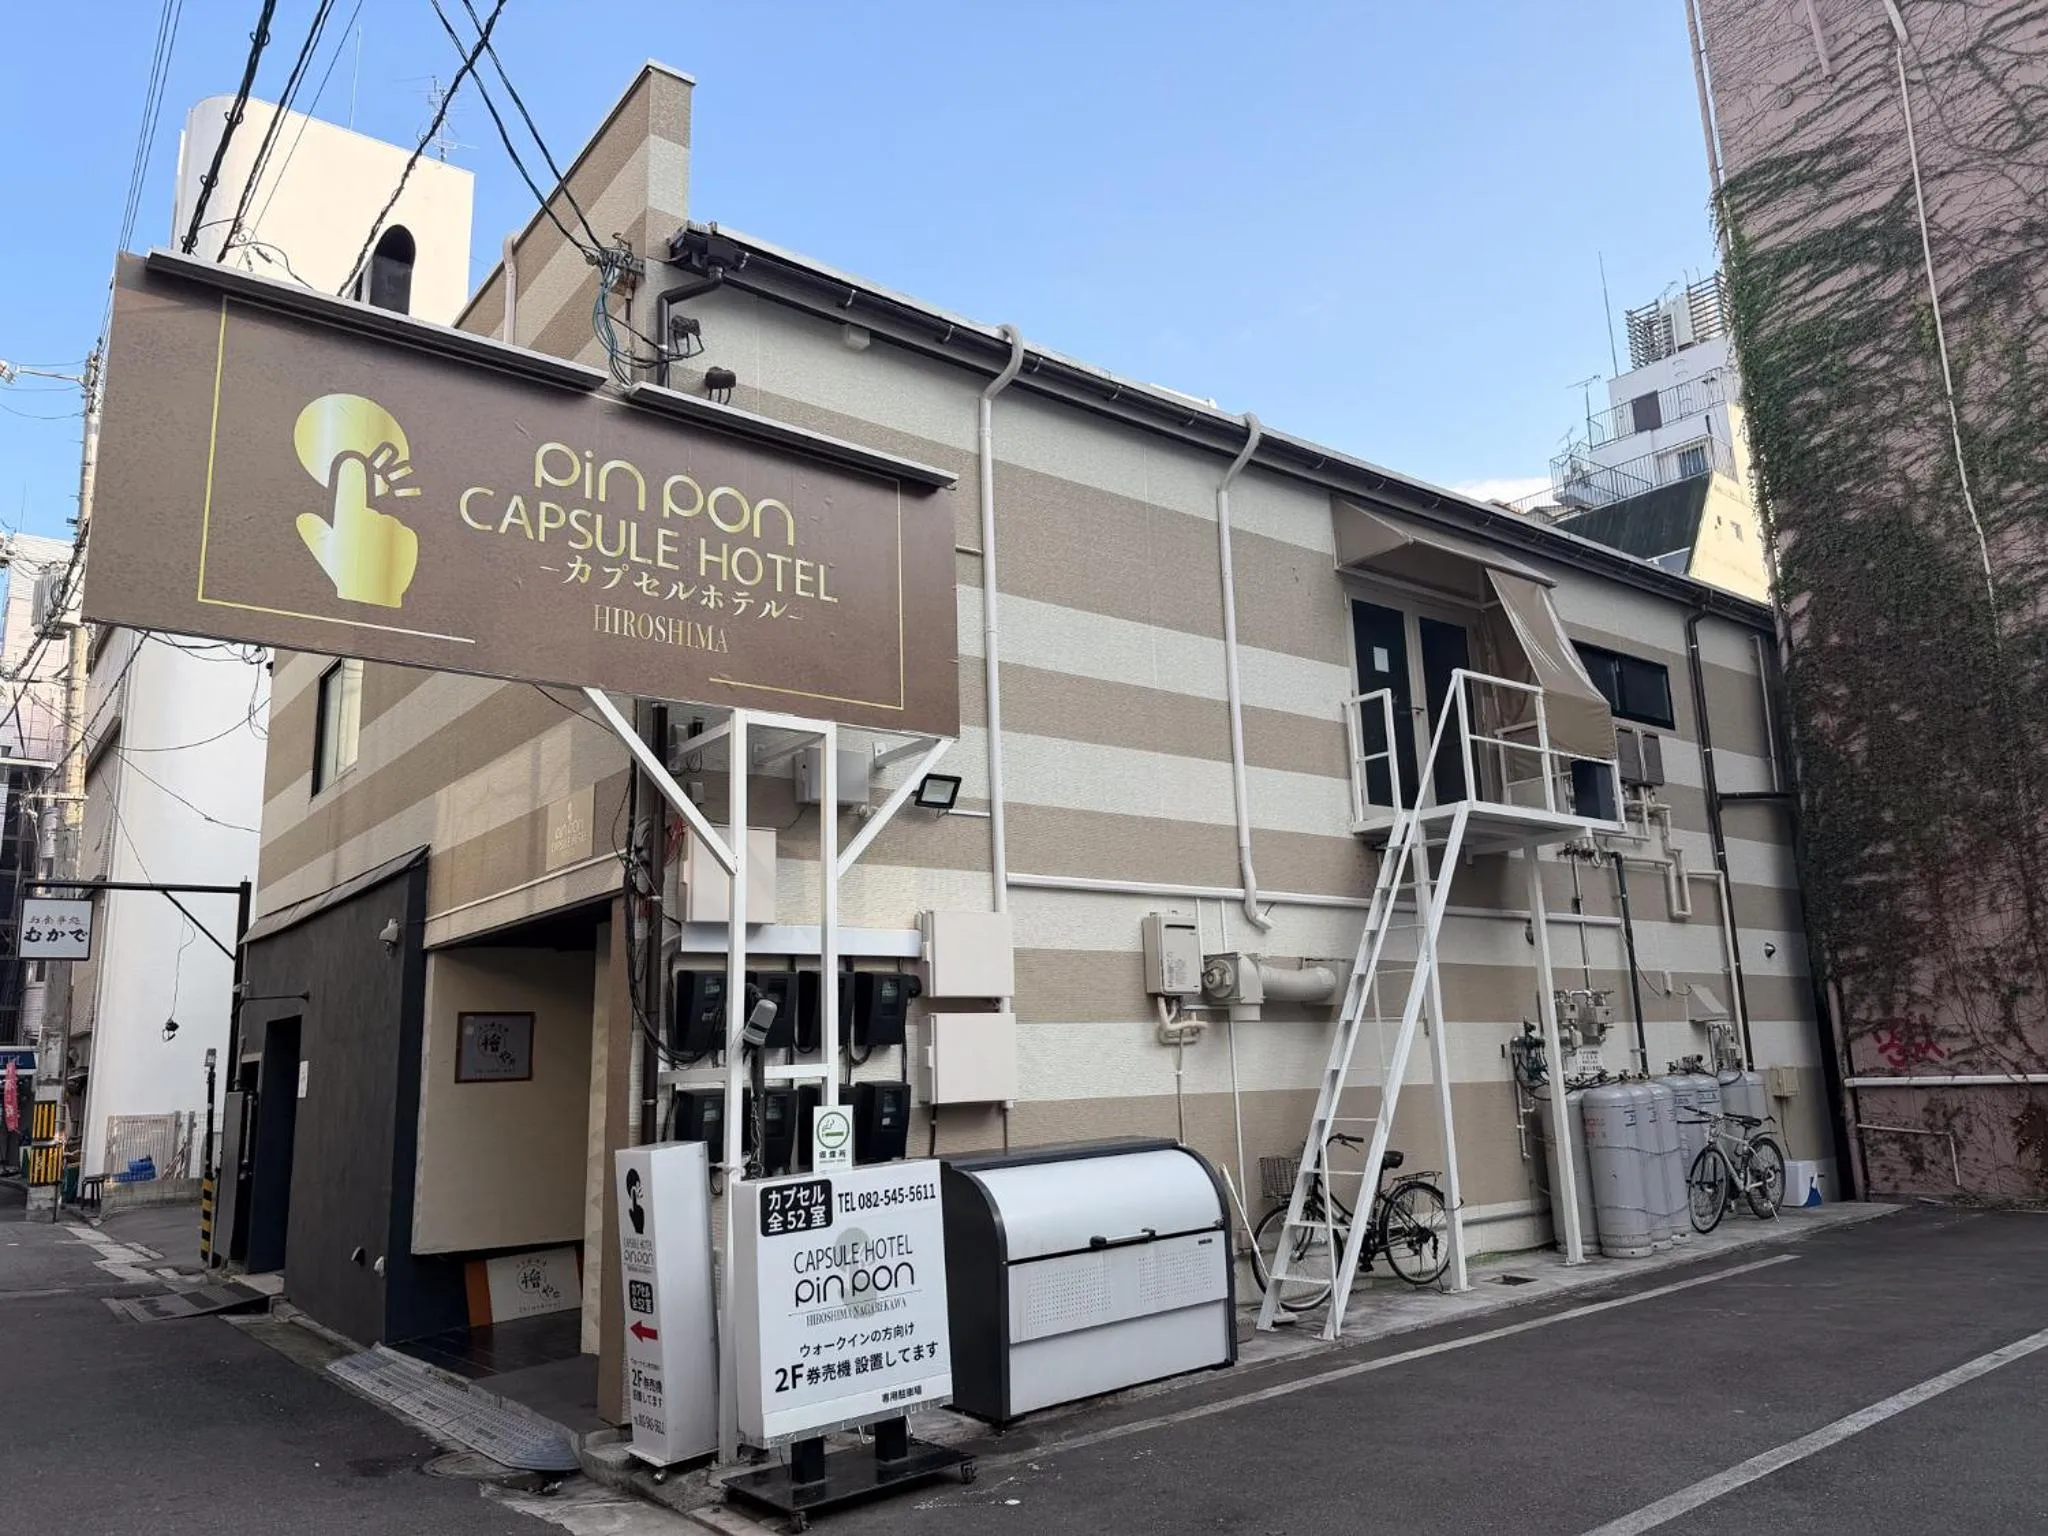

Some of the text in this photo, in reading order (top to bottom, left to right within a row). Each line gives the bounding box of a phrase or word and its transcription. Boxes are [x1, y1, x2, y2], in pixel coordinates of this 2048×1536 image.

[534, 441, 795, 546] pin pon
[459, 486, 839, 603] CAPSULE HOTEL
[593, 604, 729, 654] HIROSHIMA
[23, 926, 88, 943] むかで
[767, 1184, 826, 1211] カプセル
[838, 1183, 936, 1214] TEL 082-545-5611
[767, 1207, 827, 1233] 全52室
[794, 1234, 913, 1274] CAPSULE HOTEL
[795, 1261, 915, 1308] pin pon
[800, 1321, 915, 1359] ウォークインの方向け
[775, 1340, 939, 1393] 2F 券売機 設置してます
